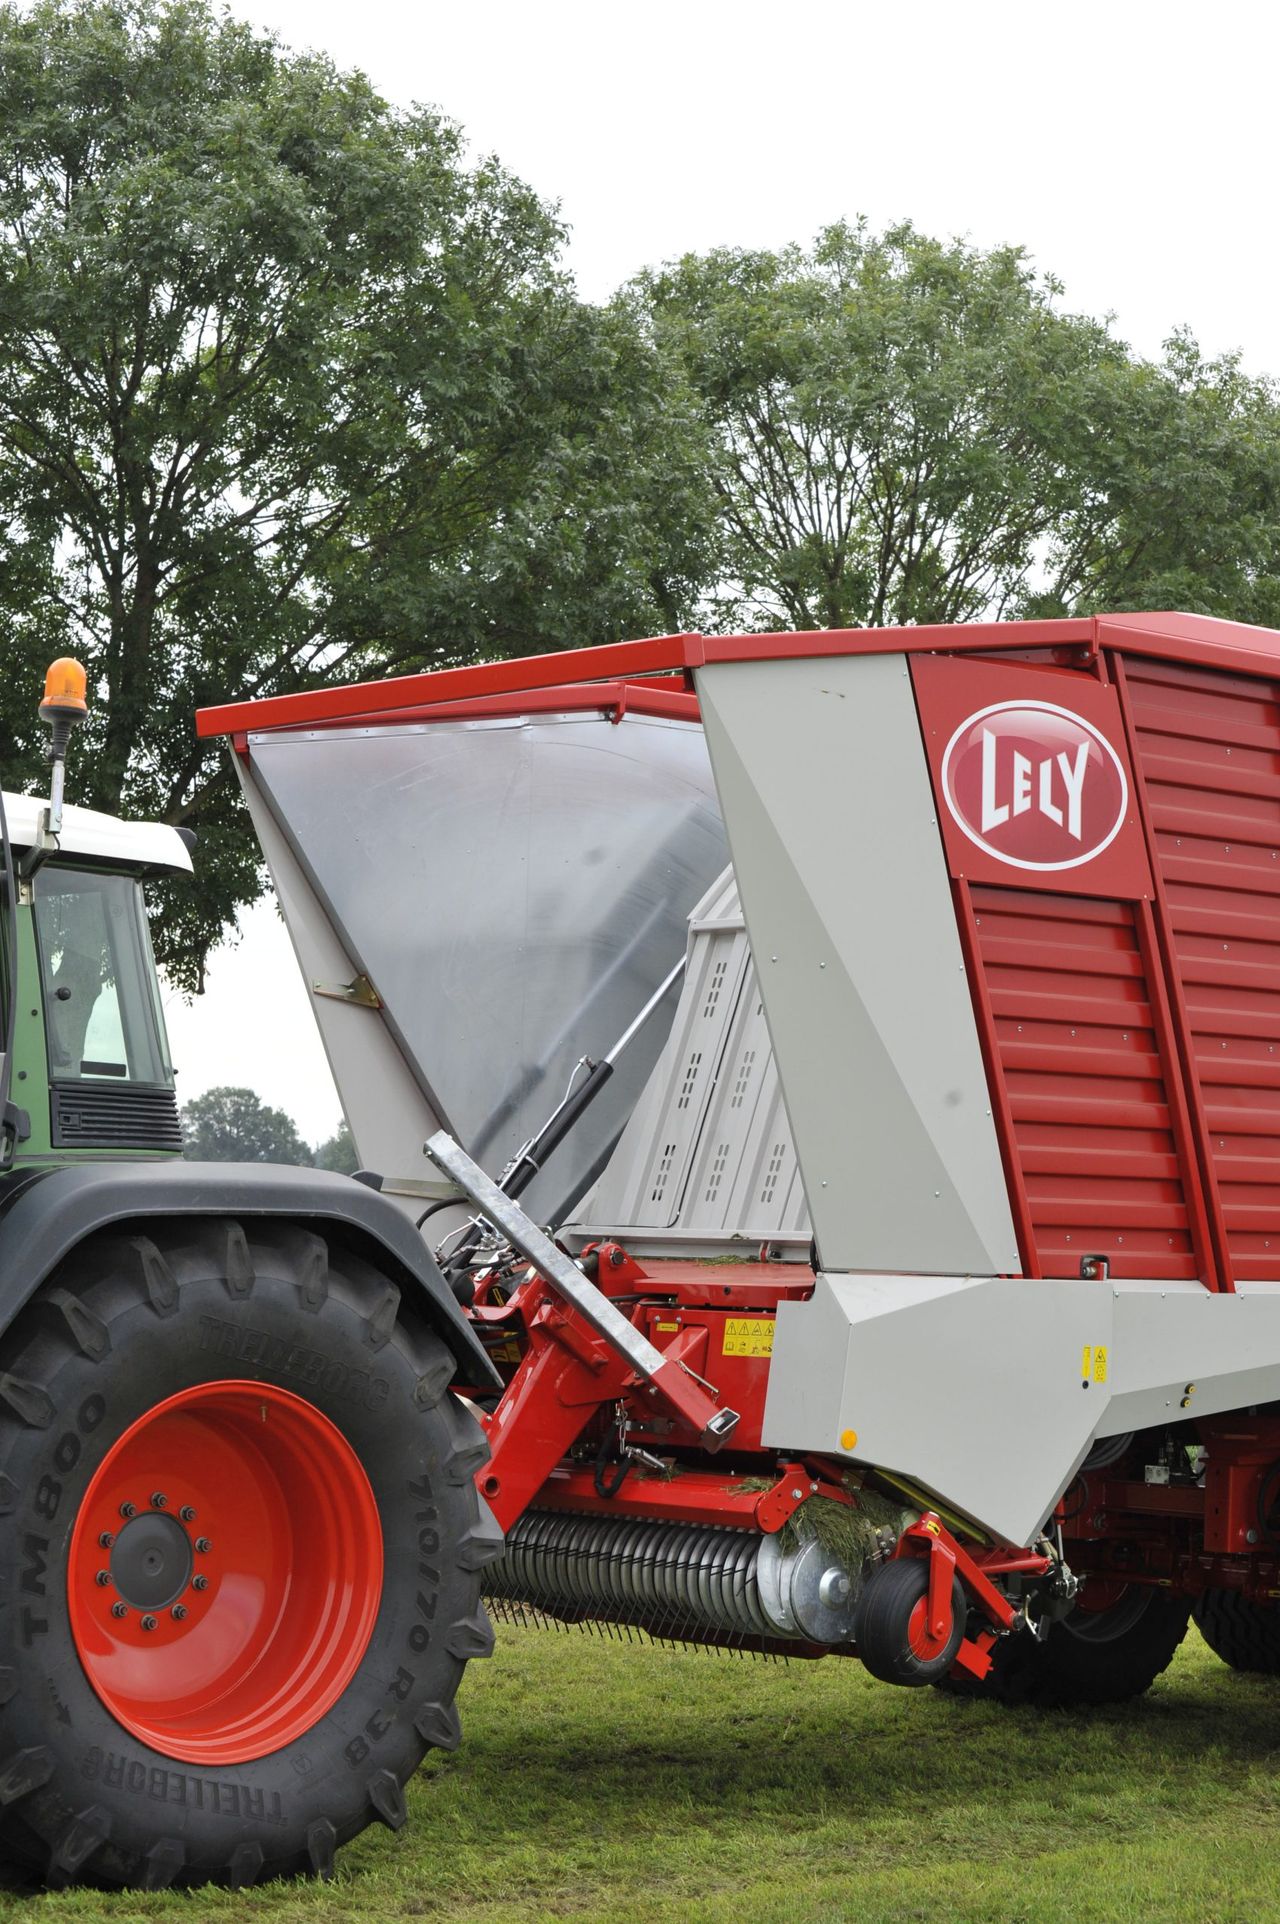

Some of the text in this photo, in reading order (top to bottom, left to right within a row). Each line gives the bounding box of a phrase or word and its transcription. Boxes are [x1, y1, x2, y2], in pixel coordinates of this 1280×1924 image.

[982, 727, 1090, 842] LELY
[200, 1313, 390, 1412] TRELLEBORG
[407, 1474, 441, 1653] 710/70
[81, 1746, 289, 1827] TRELLEBORG
